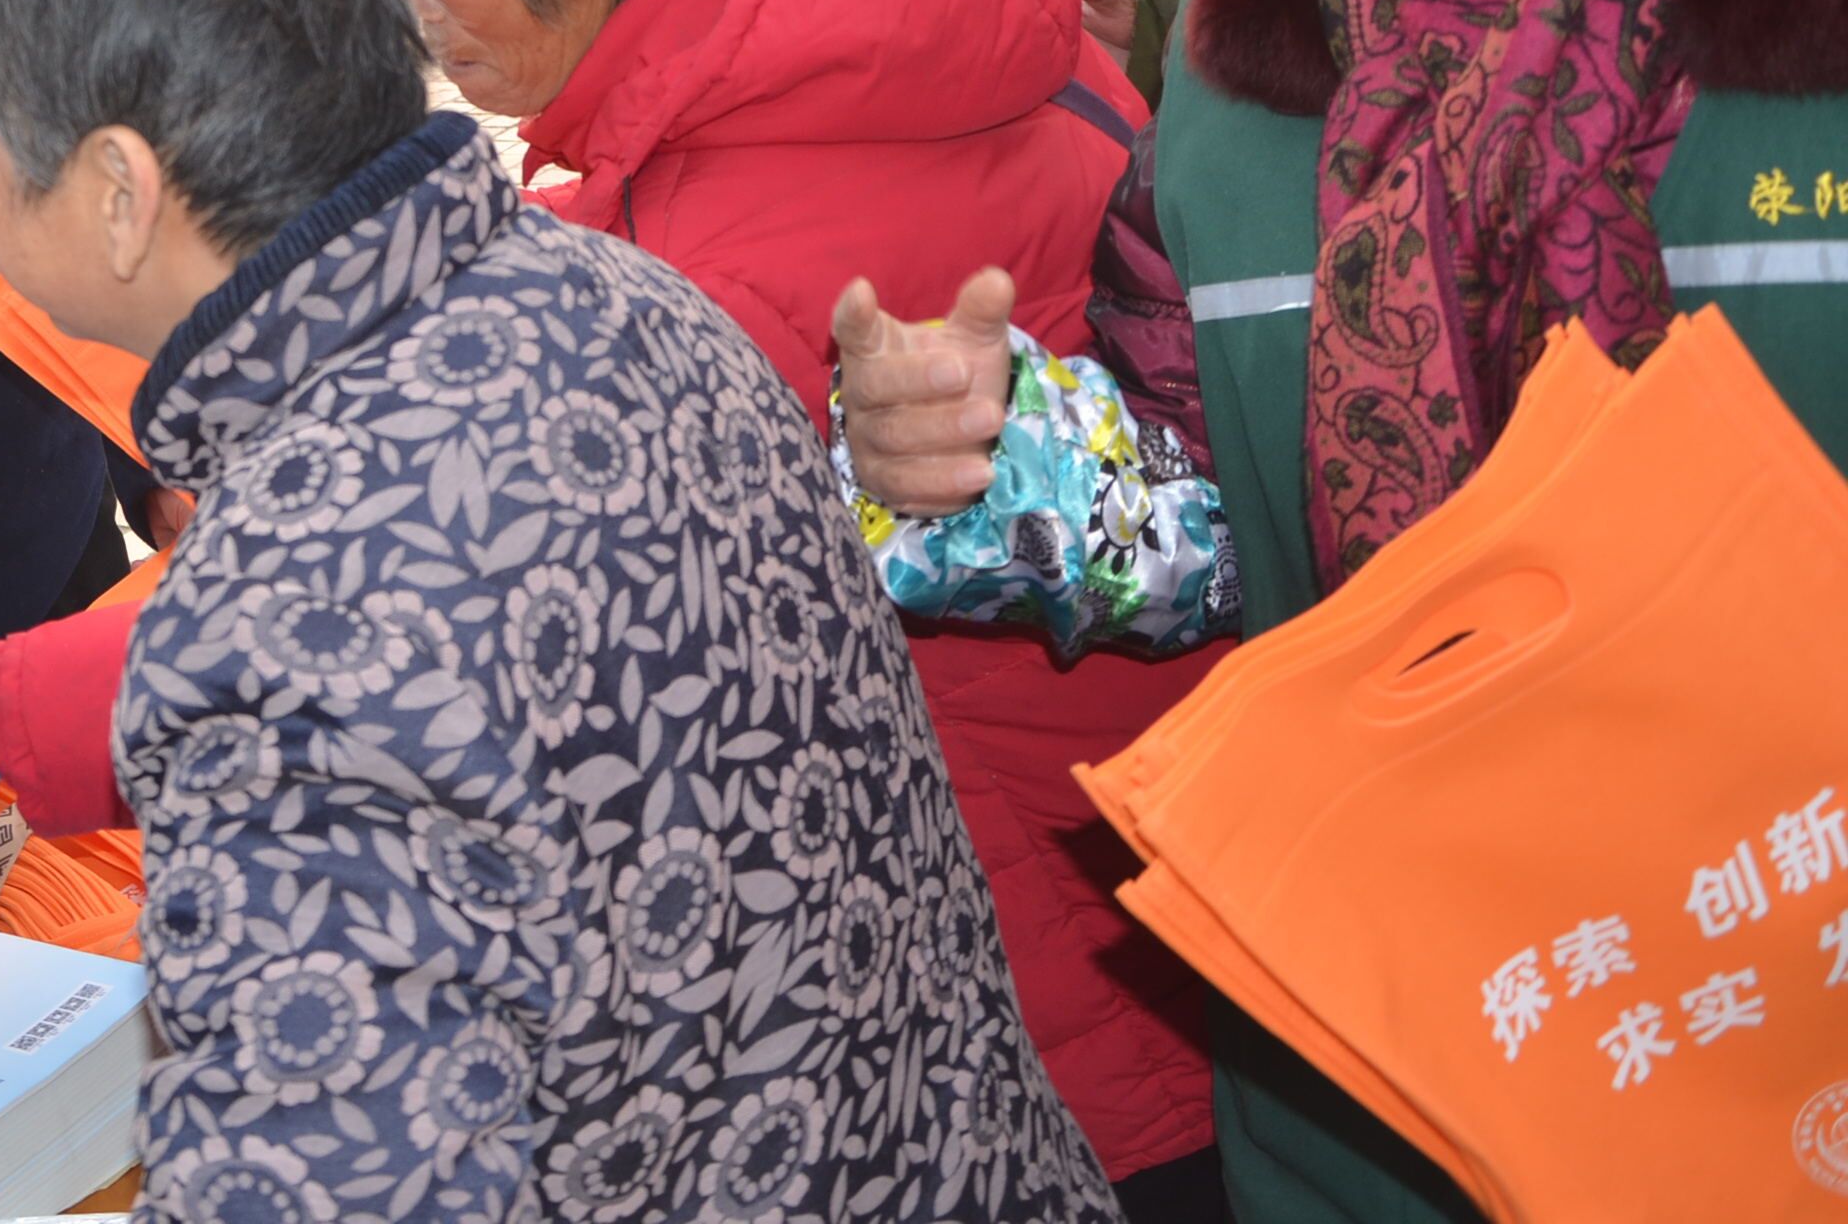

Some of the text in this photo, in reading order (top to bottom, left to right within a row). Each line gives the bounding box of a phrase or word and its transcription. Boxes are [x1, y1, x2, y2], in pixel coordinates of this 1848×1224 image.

[1480, 914, 1637, 1063] 探索
[1684, 786, 1848, 941] 创新
[1596, 966, 1767, 1091] 求实
